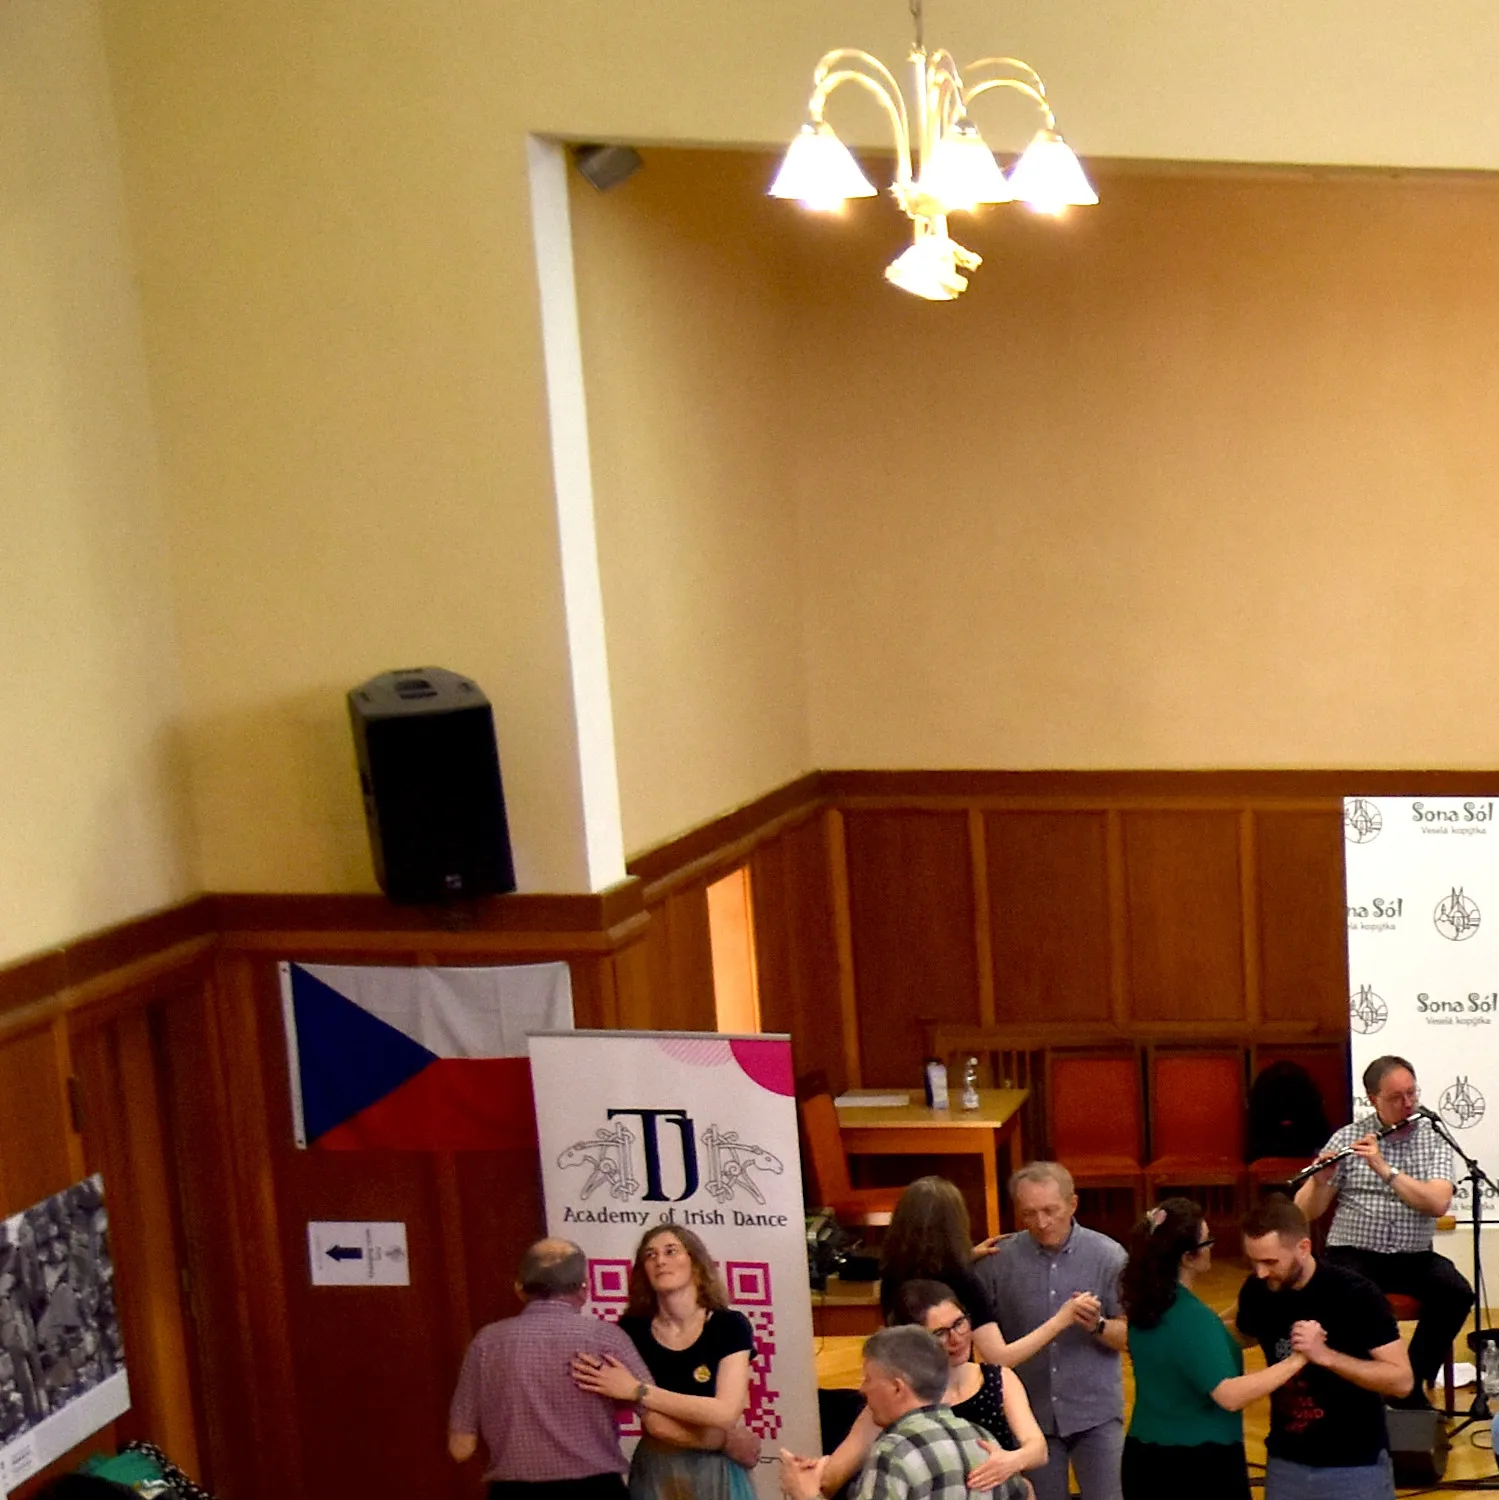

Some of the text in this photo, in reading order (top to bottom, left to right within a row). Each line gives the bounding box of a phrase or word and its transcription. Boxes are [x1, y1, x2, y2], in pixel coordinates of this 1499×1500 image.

[1412, 802, 1493, 822] Sona Sól
[1348, 898, 1403, 918] na Sól
[1417, 993, 1497, 1012] Sona Sól
[563, 1206, 787, 1227] Academy of Irish Dance
